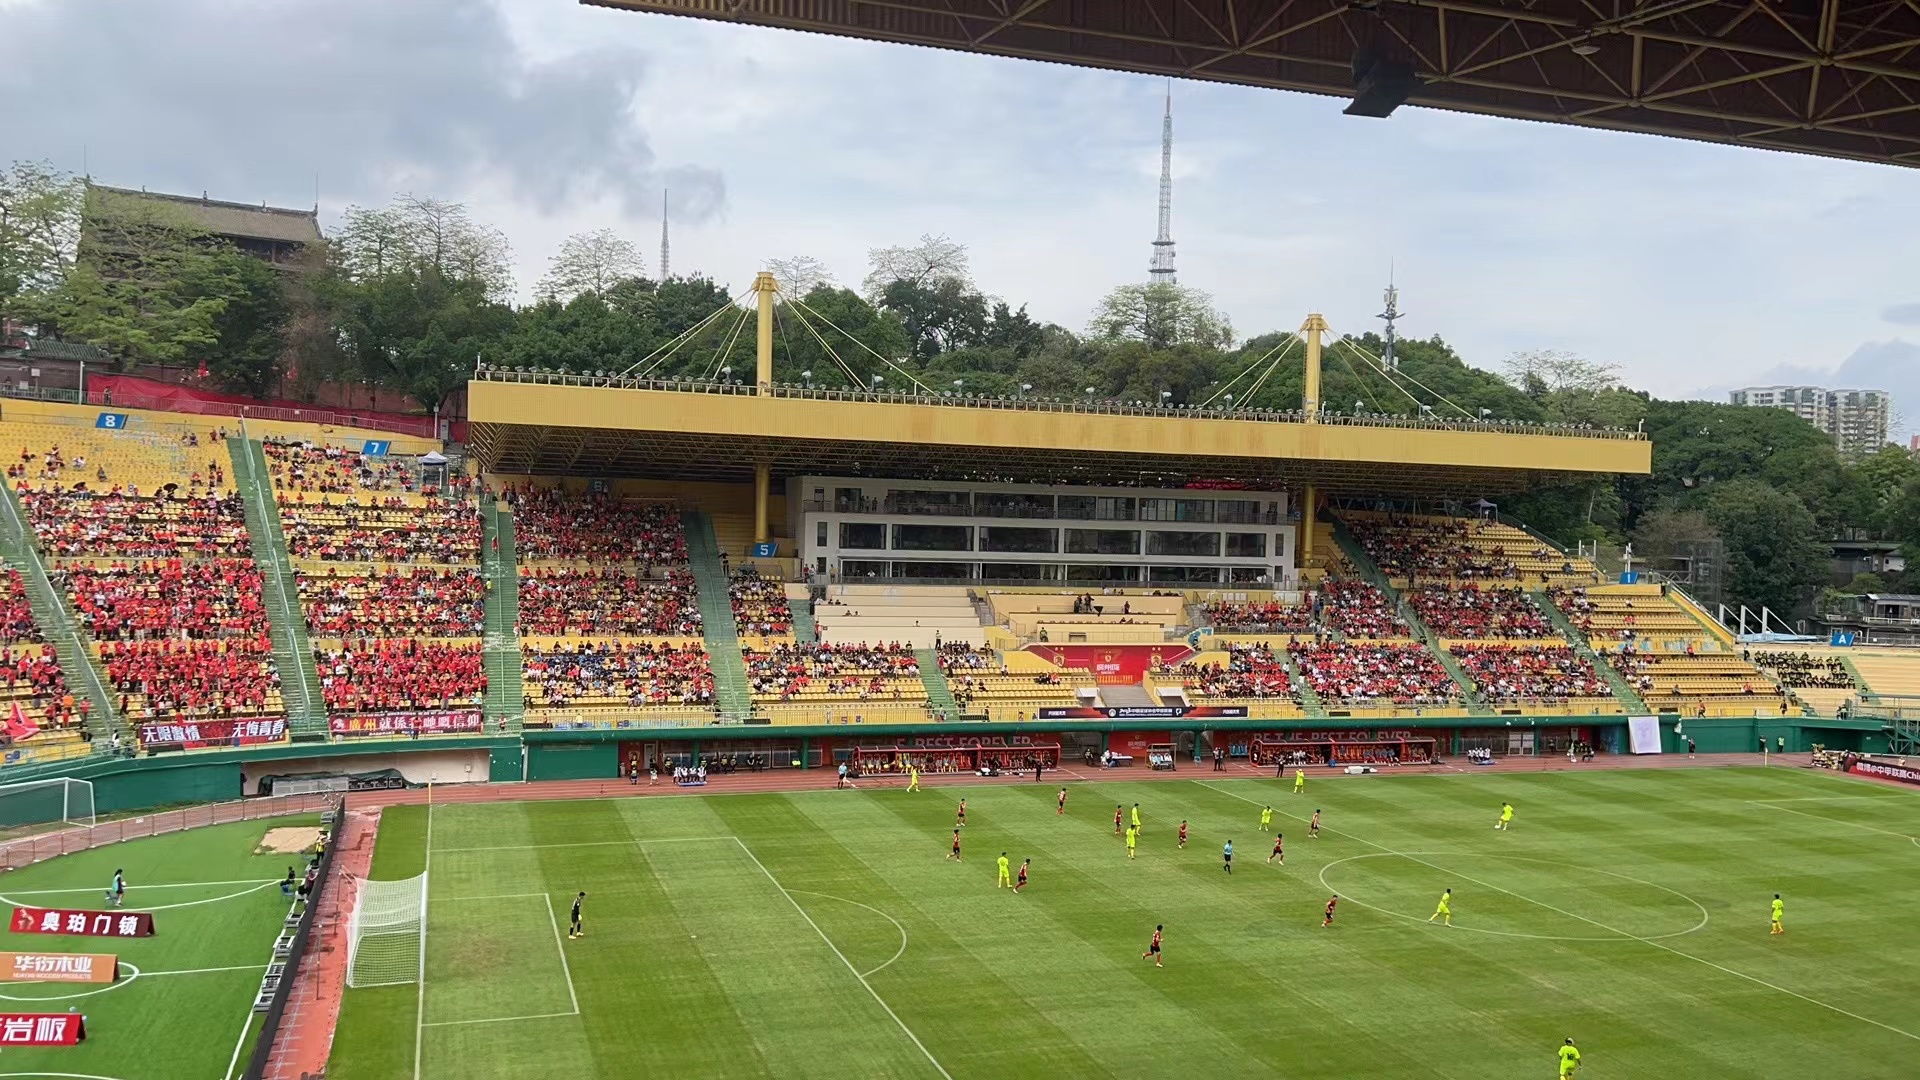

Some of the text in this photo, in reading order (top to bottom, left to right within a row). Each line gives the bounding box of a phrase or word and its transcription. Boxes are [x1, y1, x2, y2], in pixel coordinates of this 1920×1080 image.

[105, 415, 116, 427] 8
[371, 442, 380, 454] 7
[760, 544, 769, 556] 5
[1838, 634, 1847, 644] A
[141, 719, 285, 742] 无限激情 无悔青春
[41, 912, 139, 935] 奥珀门锁
[14, 955, 92, 973] 华衍木业
[0, 1017, 67, 1042] 岩板
